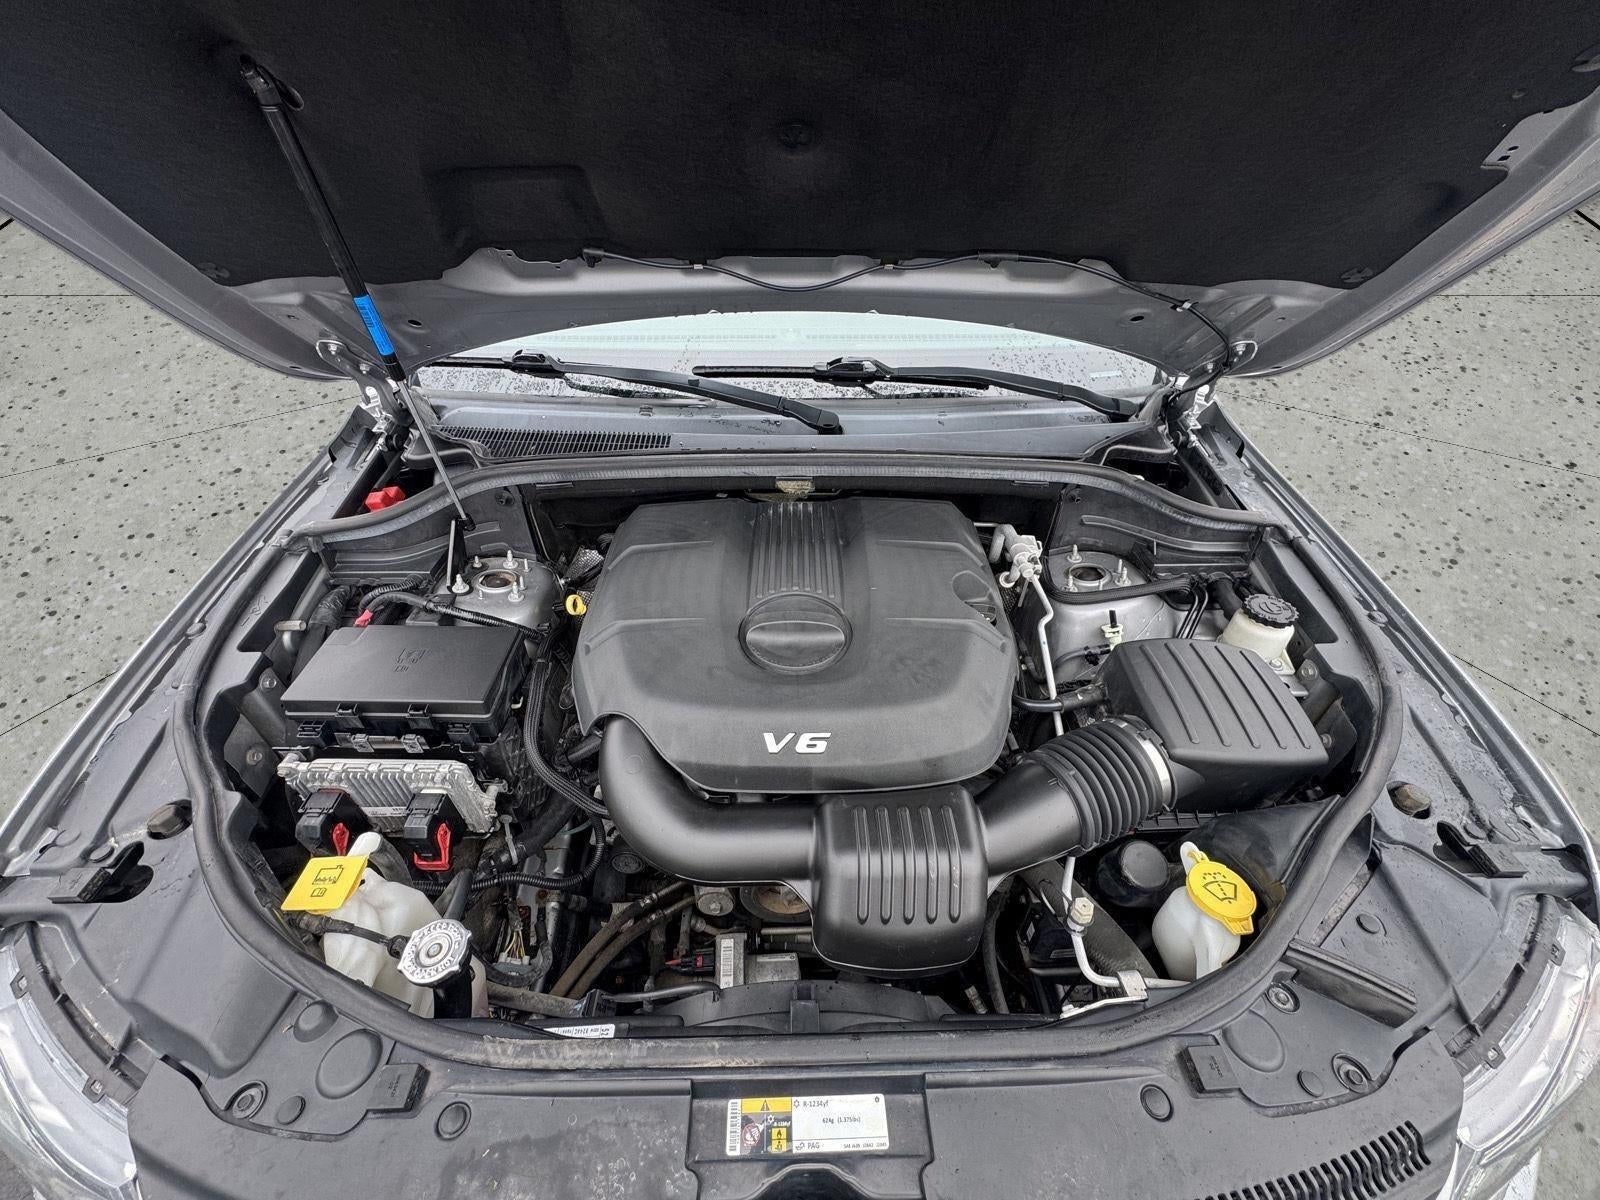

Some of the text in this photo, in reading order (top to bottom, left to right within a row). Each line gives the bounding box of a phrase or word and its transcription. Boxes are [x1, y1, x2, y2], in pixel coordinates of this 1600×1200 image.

[763, 732, 832, 754] V6
[803, 1100, 829, 1108] R-1234yf
[807, 1142, 820, 1150] PAG
